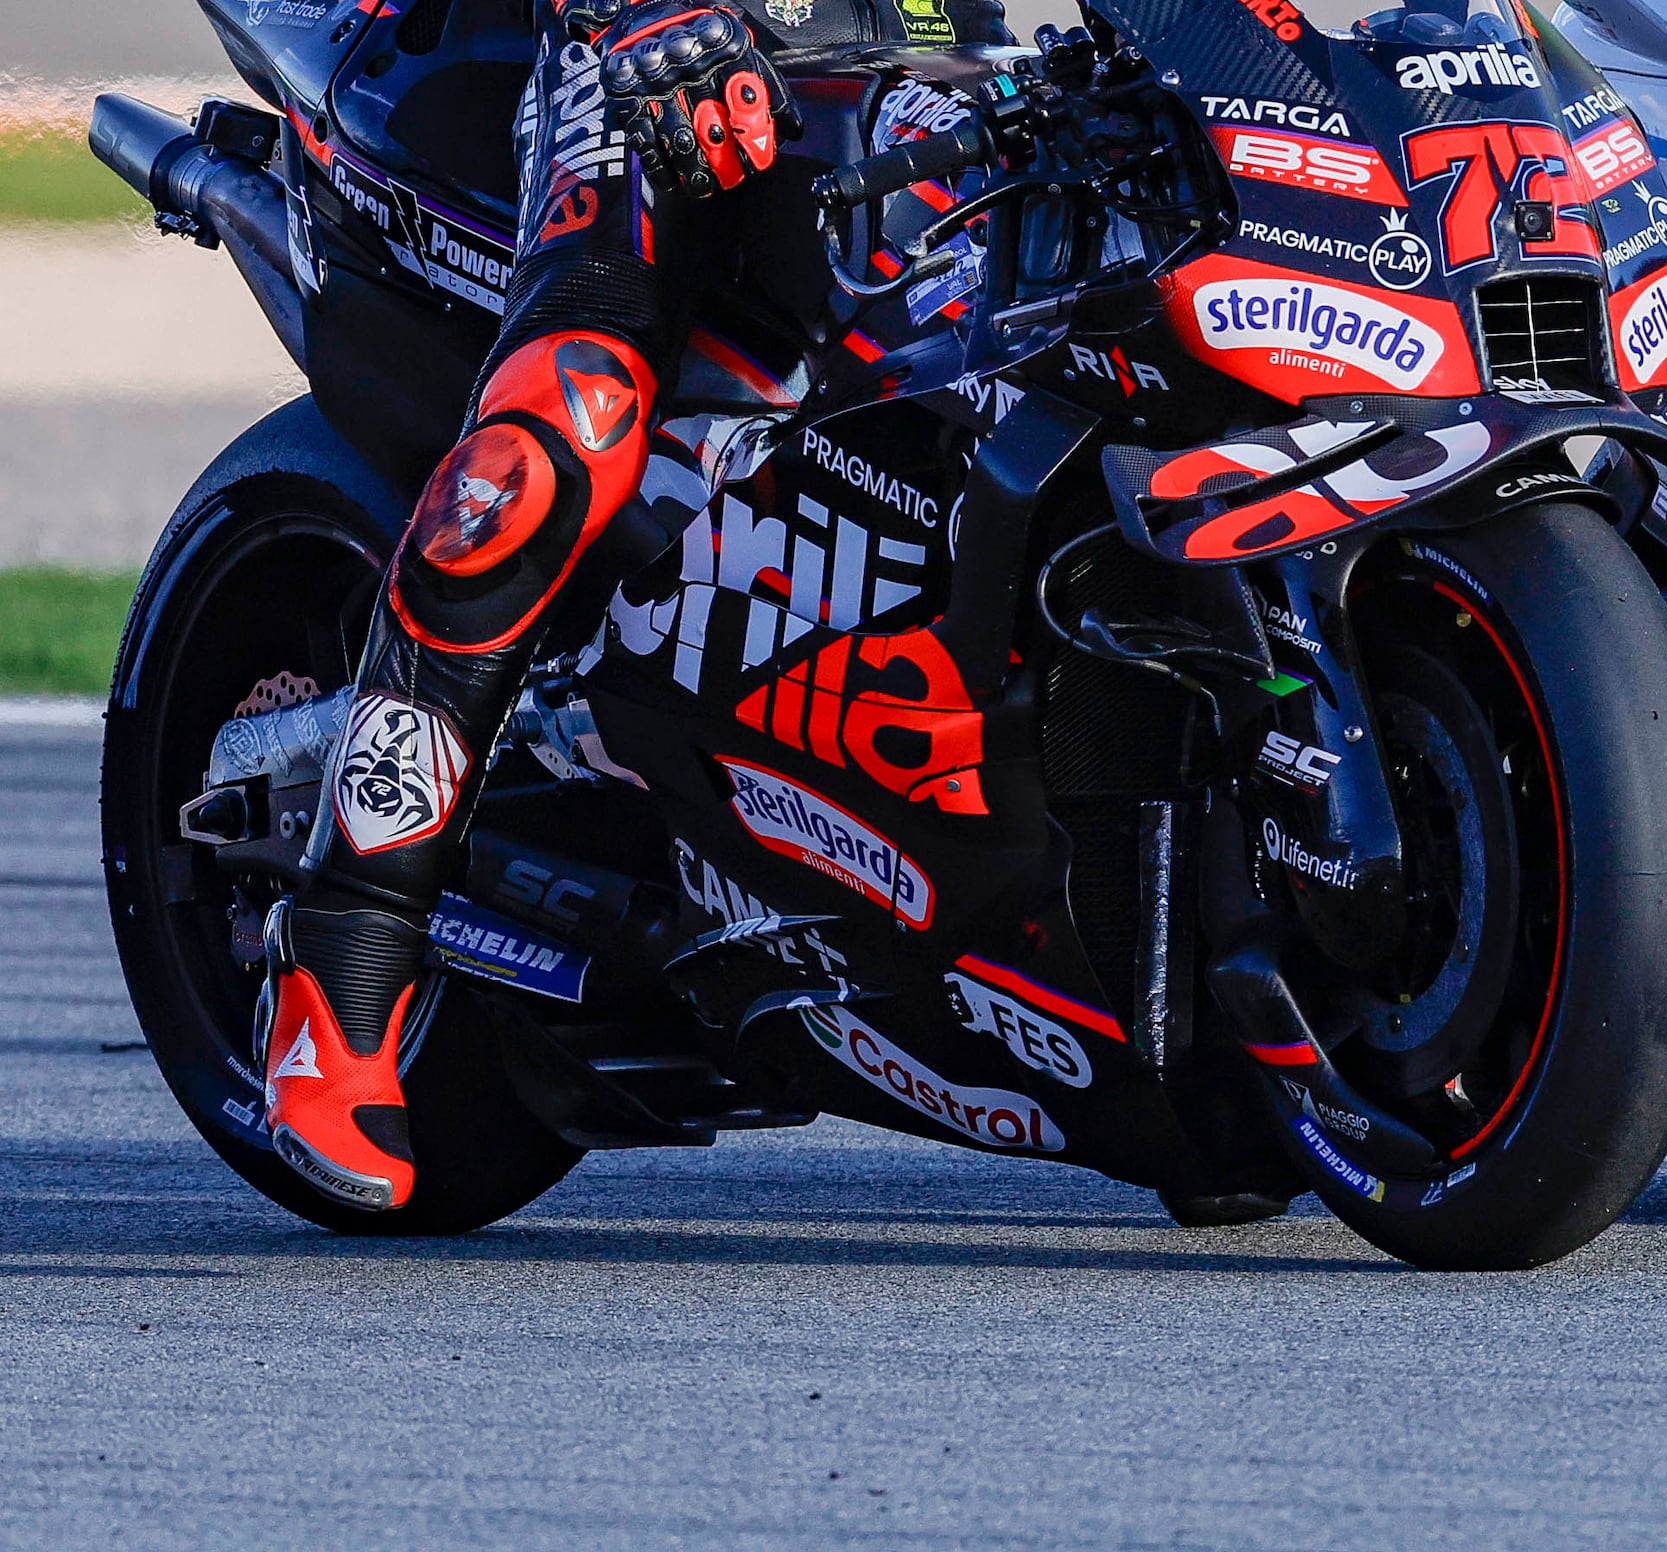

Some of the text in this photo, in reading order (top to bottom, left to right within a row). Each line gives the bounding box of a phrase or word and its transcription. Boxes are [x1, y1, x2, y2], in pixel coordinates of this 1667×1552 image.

[1396, 42, 1544, 96] aprilia
[1200, 95, 1351, 138] TARGA
[1561, 86, 1631, 130] TARGA
[1229, 162, 1370, 195] BATTERY
[1230, 133, 1379, 184] BS
[1577, 128, 1644, 184] BS
[1594, 154, 1654, 190] BATTERY
[333, 164, 514, 291] Green Power
[1238, 219, 1429, 276] PRAGMATIC PLAY
[1603, 226, 1658, 269] PRAGMATIC
[1206, 284, 1428, 374] sterilgarda
[1268, 348, 1348, 380] alimenti
[801, 426, 939, 529] PRAGMATIC
[1423, 546, 1489, 601] MICHELIN
[1265, 622, 1322, 655] COMPOSITI
[1267, 604, 1307, 635] PAN
[1256, 755, 1327, 788] PROJECT
[1262, 731, 1343, 781] SC
[370, 781, 392, 797] 72
[736, 774, 915, 905] sterilgarda
[500, 859, 597, 924] SC
[801, 851, 866, 897] alimenti
[987, 1000, 1080, 1079] FES
[848, 1029, 1046, 1148] Castrol
